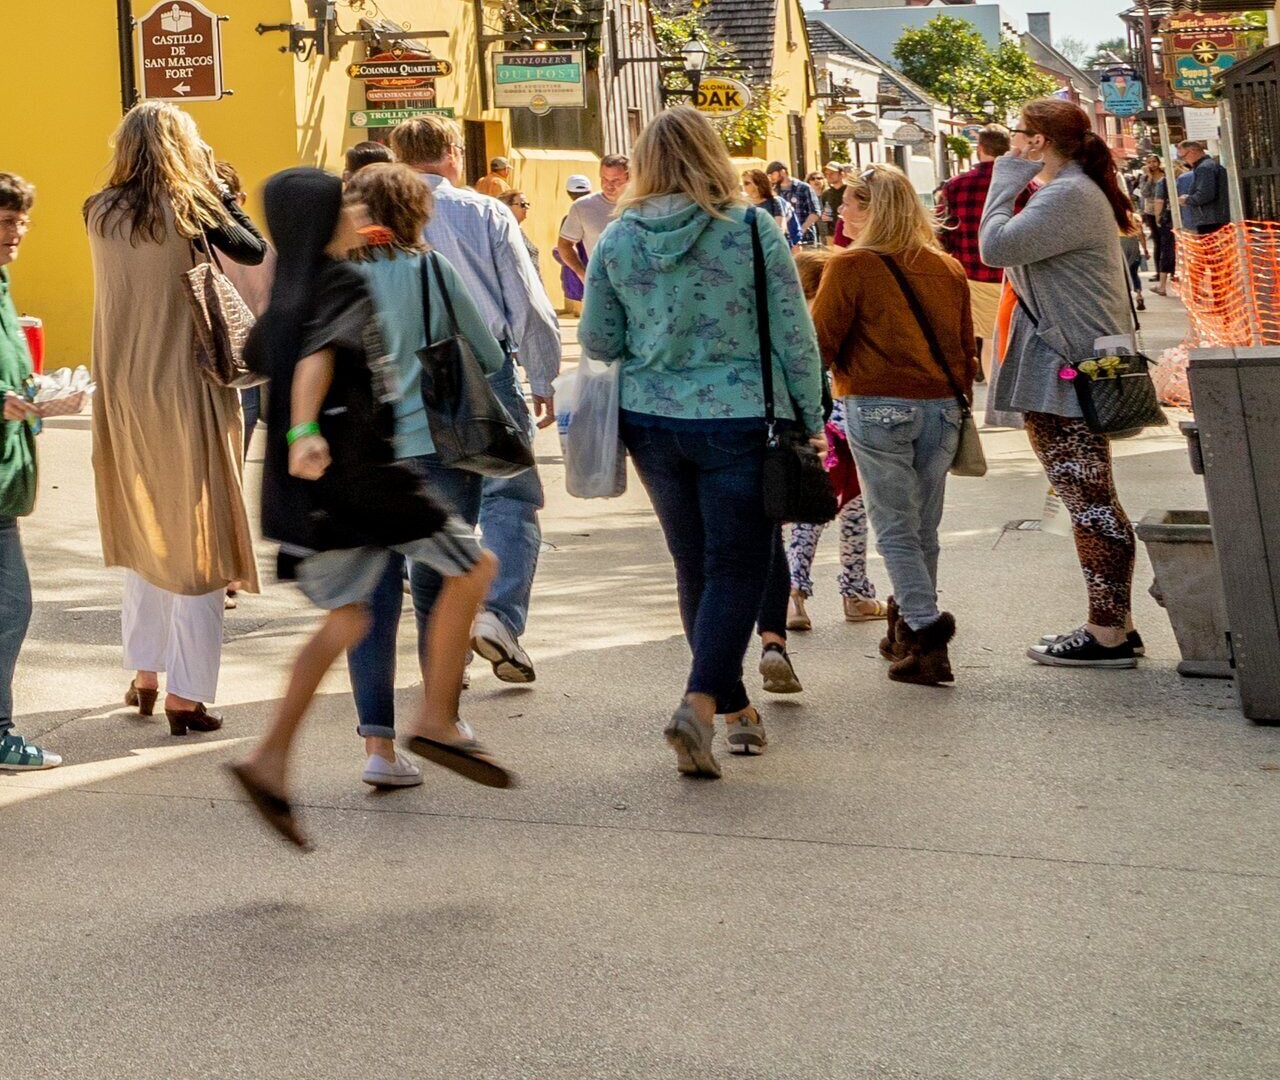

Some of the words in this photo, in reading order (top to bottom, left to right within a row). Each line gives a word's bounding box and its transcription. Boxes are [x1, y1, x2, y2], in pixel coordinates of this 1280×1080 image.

[152, 34, 203, 45] CASTILLO
[171, 46, 185, 55] DE
[145, 59, 165, 68] SAN
[168, 56, 213, 67] MARCOS
[509, 56, 567, 64] EXPLORER'S
[165, 68, 193, 78] FORT
[360, 66, 398, 75] COLONIAL
[400, 64, 437, 76] QUARTER
[499, 69, 576, 79] OUTPOST
[370, 111, 409, 119] TROLLEY
